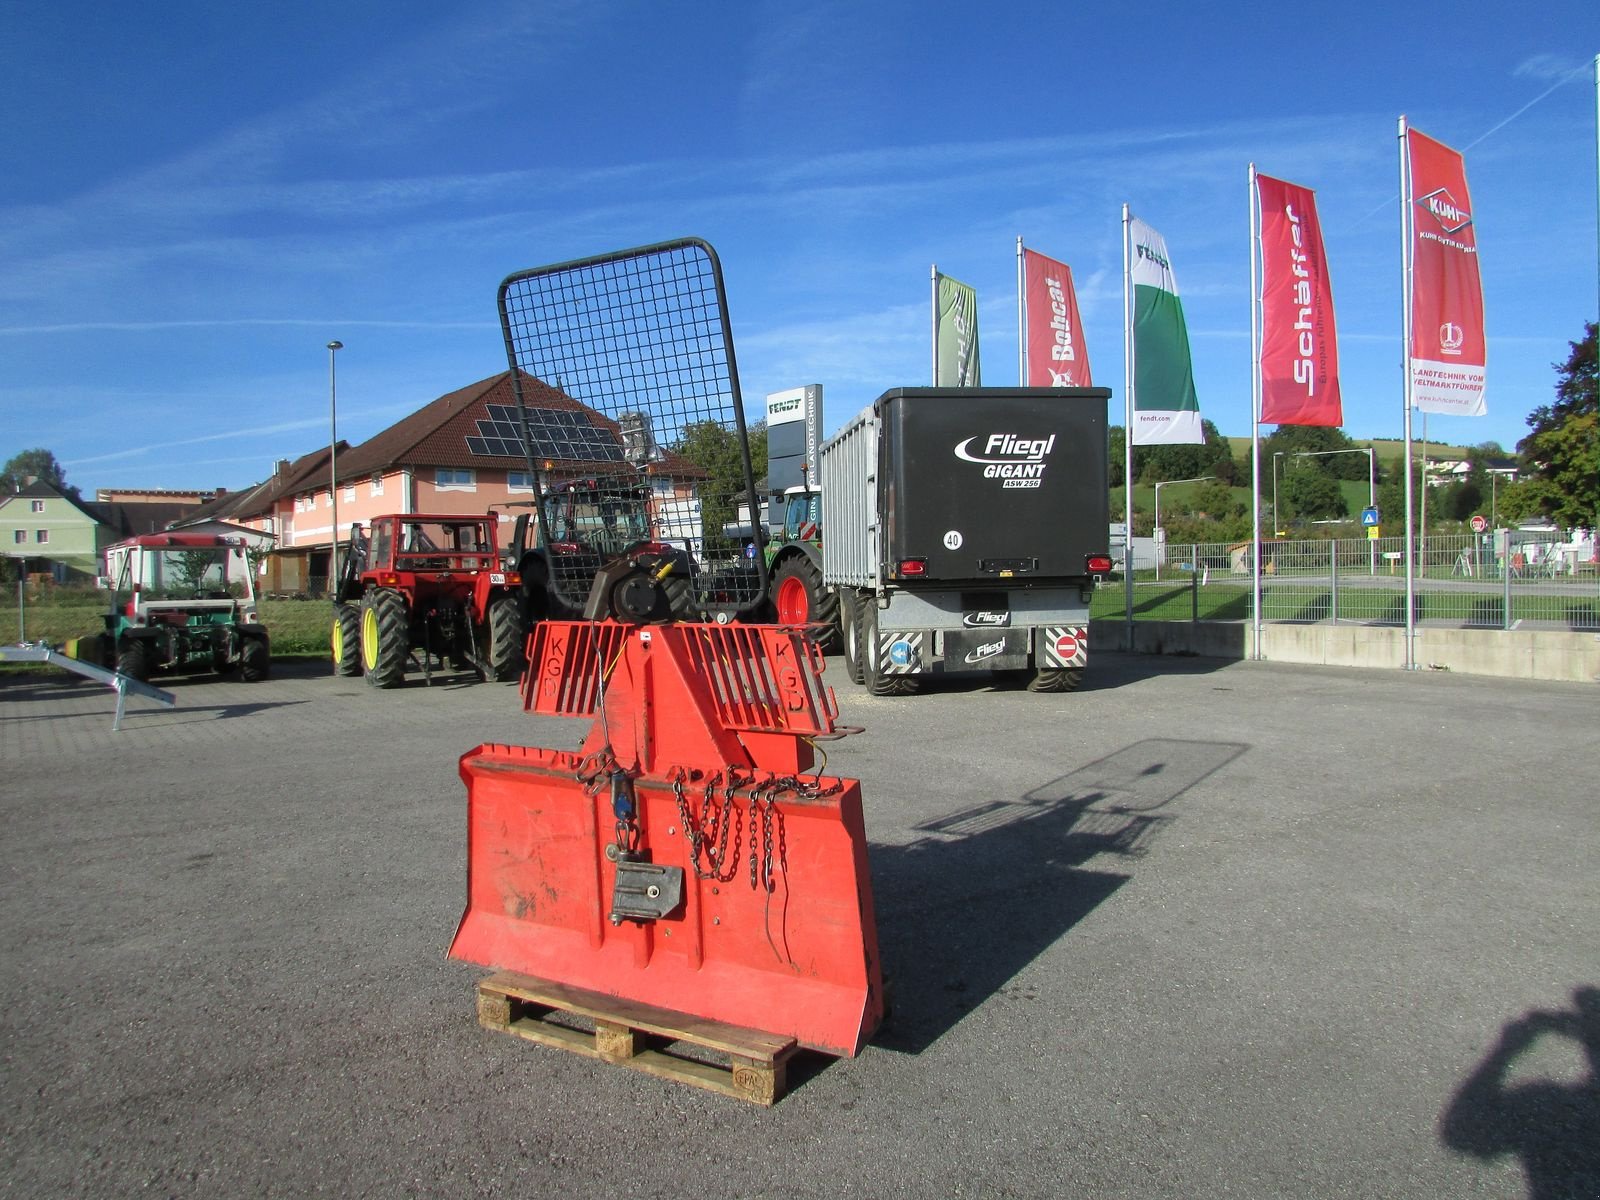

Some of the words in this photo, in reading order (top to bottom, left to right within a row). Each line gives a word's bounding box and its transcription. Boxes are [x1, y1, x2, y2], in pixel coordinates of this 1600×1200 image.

[1285, 204, 1314, 396] Schäffer
[1413, 368, 1467, 381] LANDTECHNIK
[1468, 374, 1484, 382] VOM
[768, 398, 802, 414] FENDT
[807, 391, 815, 468] LANDTECHNIK
[984, 434, 1056, 460] Fliegl
[983, 464, 1046, 478] GIGANT
[947, 534, 959, 546] 40
[491, 574, 499, 583] 30
[976, 611, 1009, 625] Fliegl
[976, 636, 1006, 657] Fliegl
